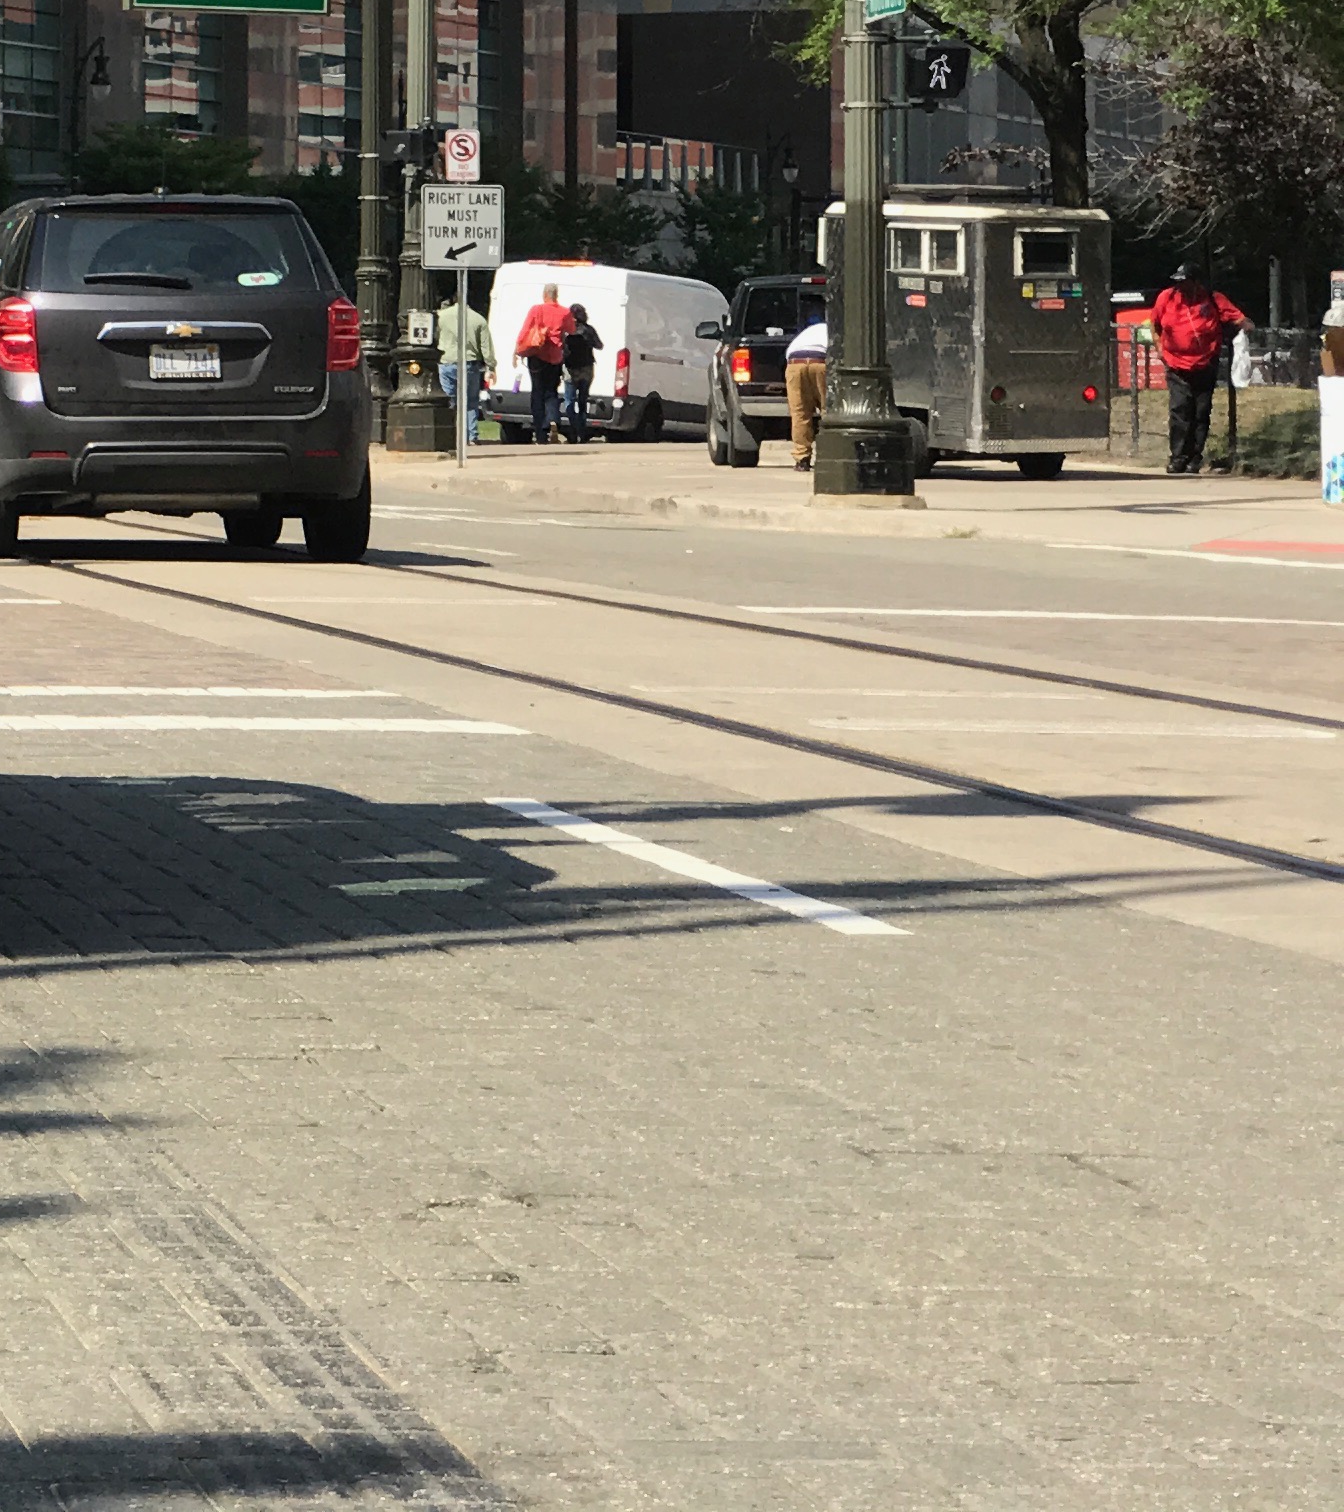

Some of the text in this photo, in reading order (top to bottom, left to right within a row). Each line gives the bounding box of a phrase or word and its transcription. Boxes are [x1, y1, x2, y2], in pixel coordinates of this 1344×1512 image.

[428, 192, 498, 206] RIGHT LANE
[447, 210, 478, 222] MUST
[428, 226, 498, 239] TURN RIGHT
